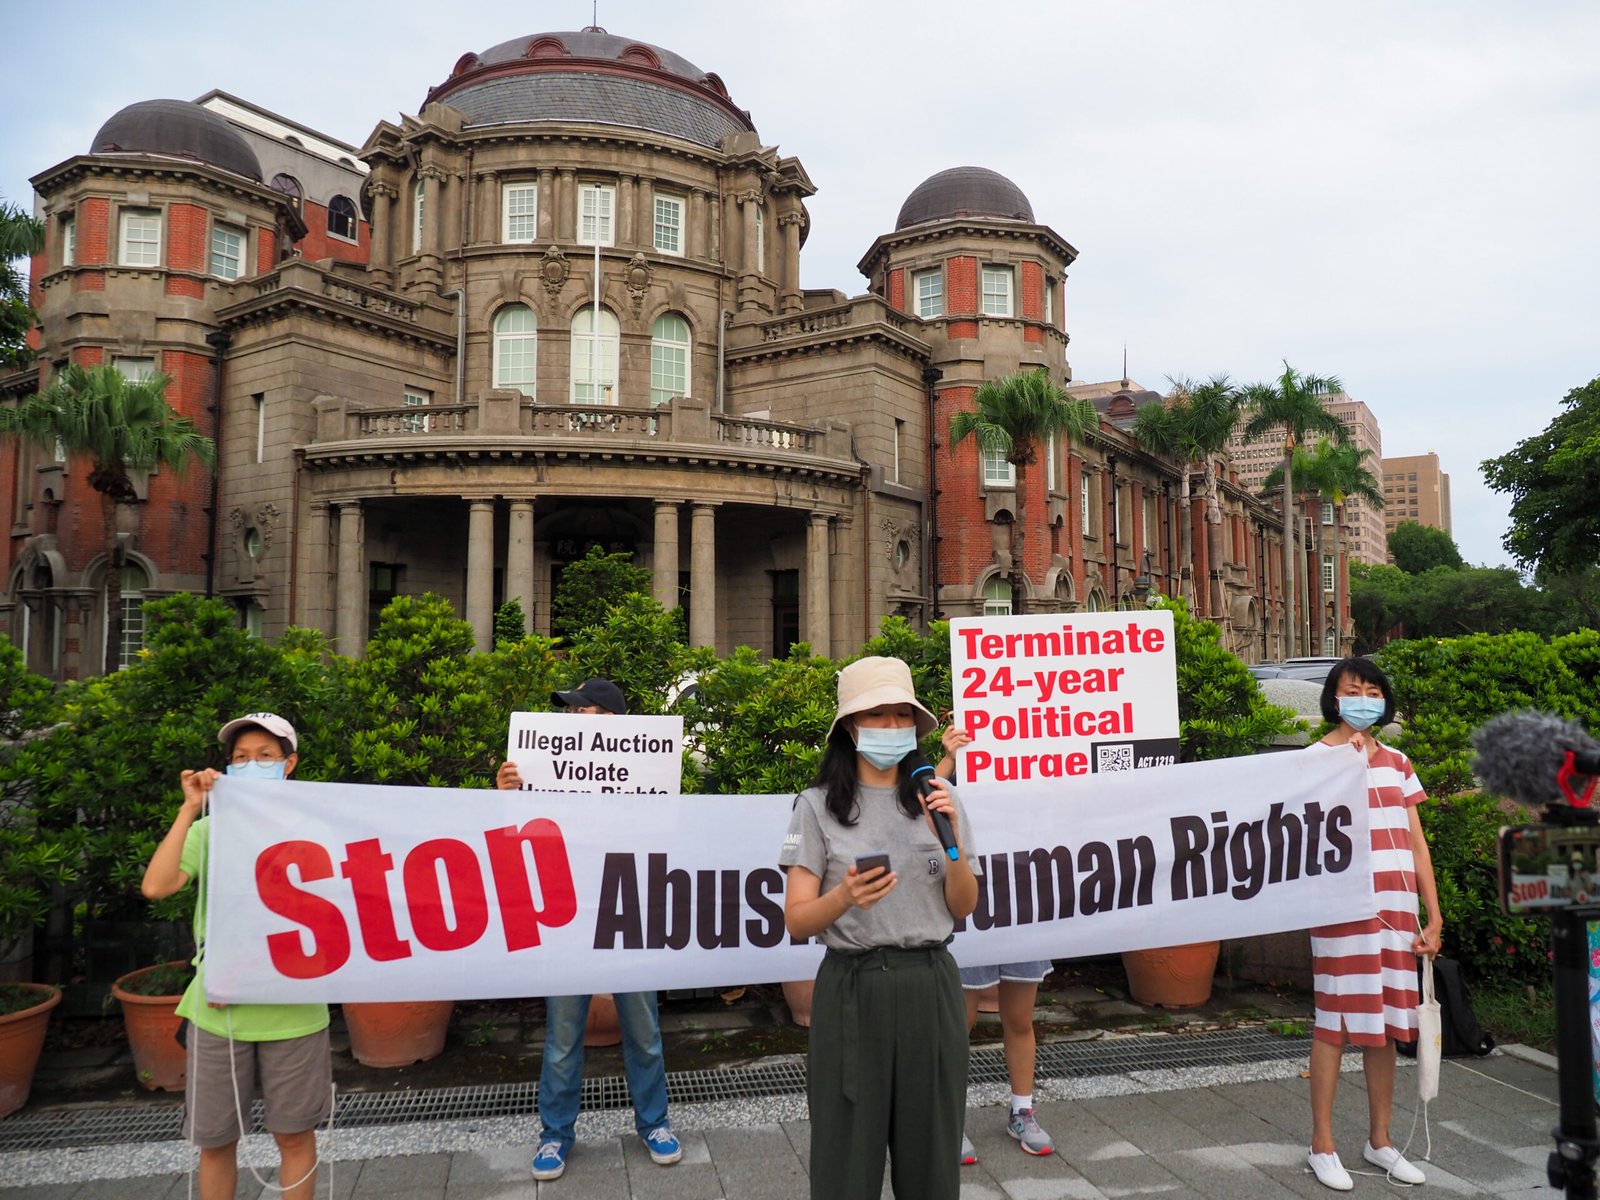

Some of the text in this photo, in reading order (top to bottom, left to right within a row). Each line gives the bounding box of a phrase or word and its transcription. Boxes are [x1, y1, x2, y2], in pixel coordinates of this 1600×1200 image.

[958, 623, 1165, 659] Terminate
[962, 666, 1125, 702] 24-year
[964, 702, 1134, 741] Political
[518, 729, 673, 756] Illegal Auction
[553, 760, 629, 782] Violate
[1137, 755, 1175, 768] ACT 1219
[928, 859, 939, 876] B
[254, 801, 1353, 979] Stop Abus uman Rights
[1511, 880, 1548, 904] Stop
